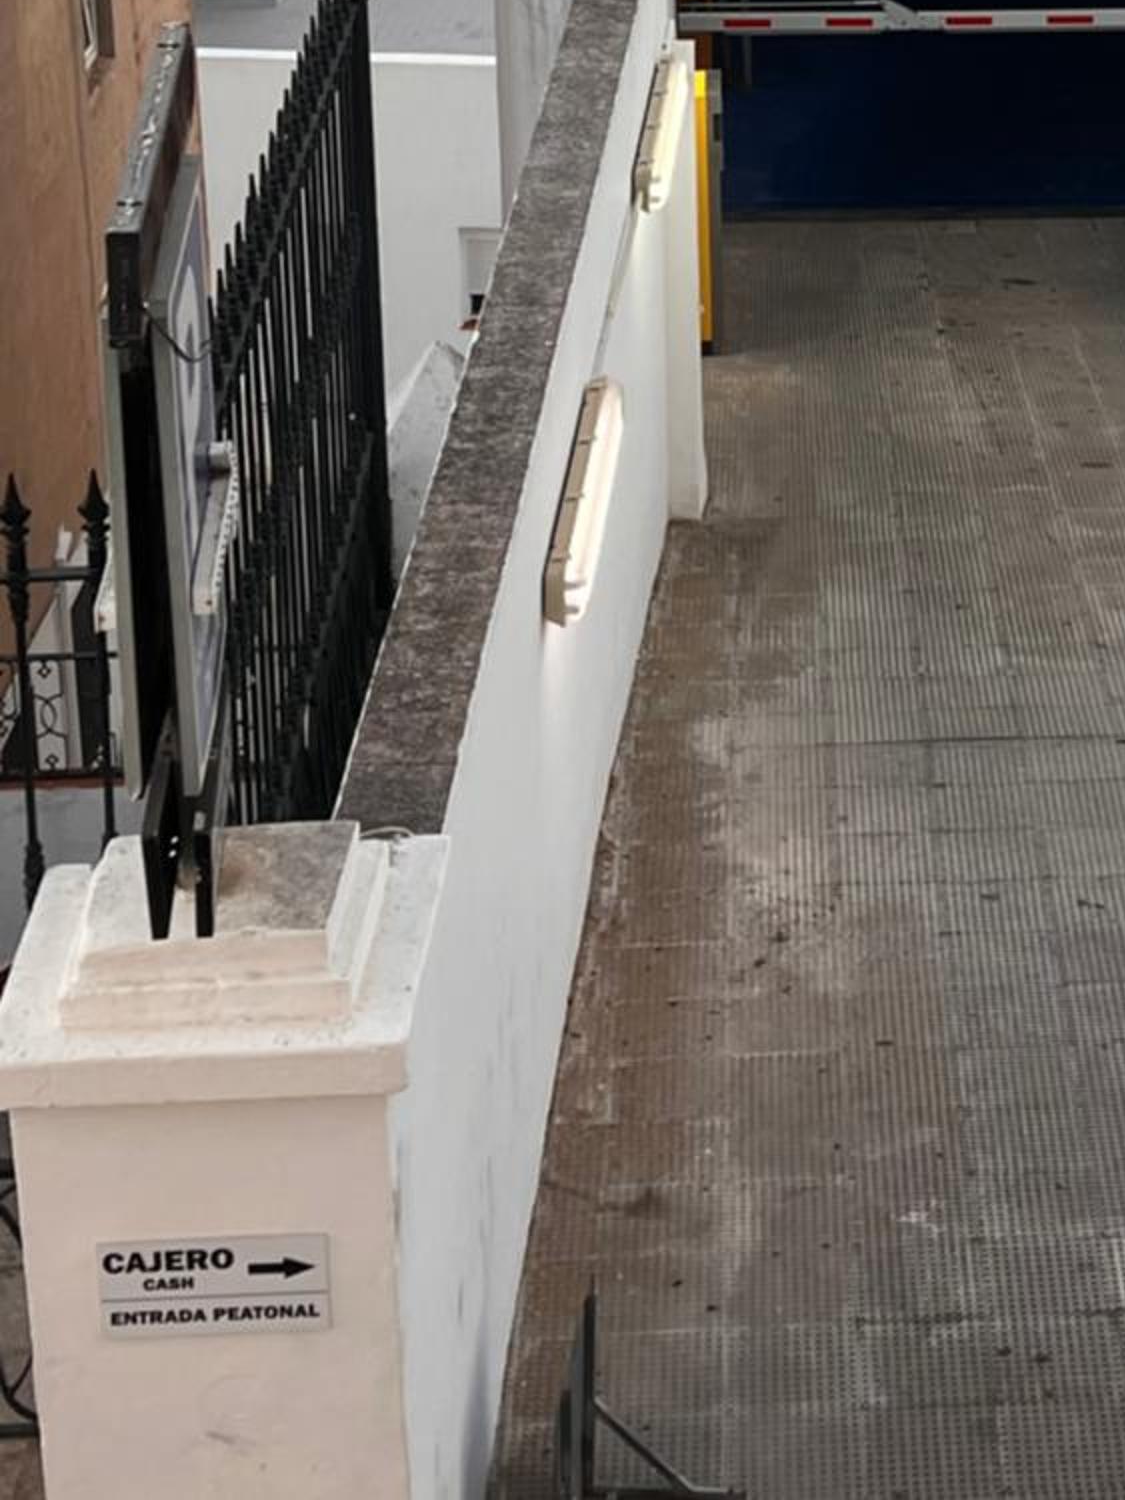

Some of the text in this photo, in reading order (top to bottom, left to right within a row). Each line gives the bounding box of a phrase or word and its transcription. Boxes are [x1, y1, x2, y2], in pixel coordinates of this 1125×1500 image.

[102, 1247, 235, 1275] CAJERO
[142, 1276, 195, 1292] CASH
[110, 1303, 321, 1327] ENTRADA PEATONAL
